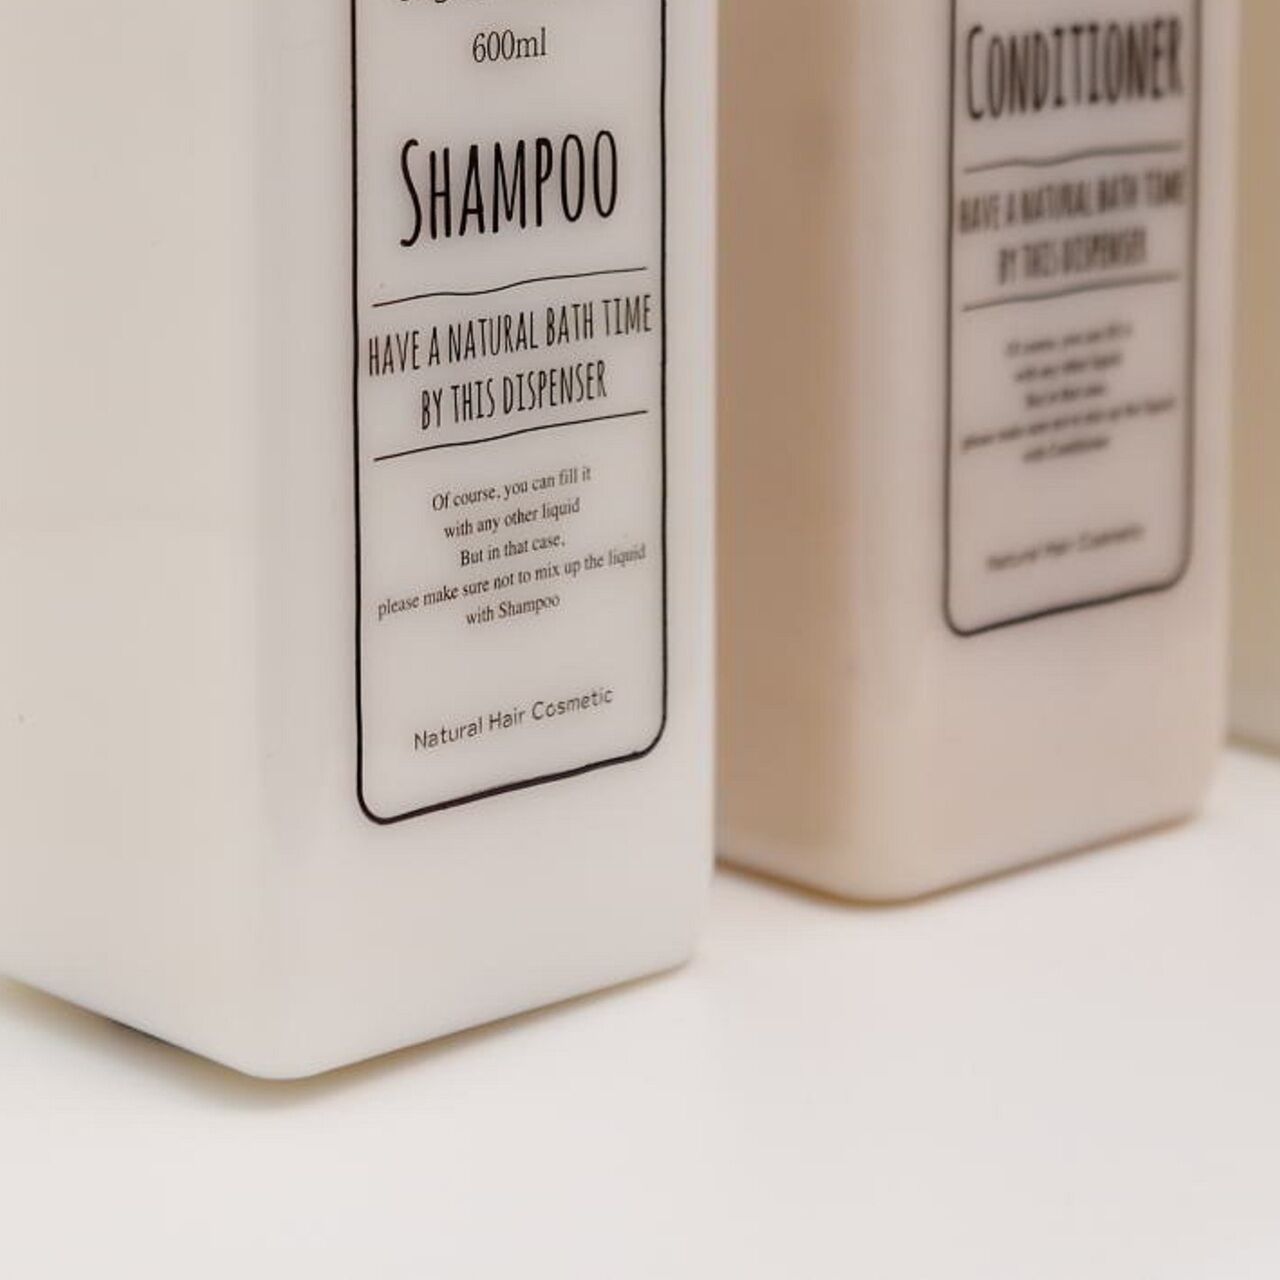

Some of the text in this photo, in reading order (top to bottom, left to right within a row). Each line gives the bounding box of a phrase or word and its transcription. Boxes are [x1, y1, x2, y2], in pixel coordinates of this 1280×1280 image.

[472, 27, 548, 63] 600ml
[966, 16, 1184, 122] CONDITIONER
[400, 130, 618, 247] SHAMPOO
[369, 294, 652, 376] HAVE A NATURAL BATH TIME
[421, 360, 607, 430] BY THIS DISPENSER
[432, 490, 450, 511] Of
[504, 481, 528, 500] you
[532, 477, 555, 492] can
[559, 468, 577, 486] fill
[582, 466, 591, 481] it
[444, 497, 580, 538] with any other liquid
[378, 542, 646, 621] please make sure not to mix up the liquid
[460, 548, 483, 567] But
[488, 544, 501, 560] in
[504, 539, 528, 557] that
[466, 595, 560, 624] with Shampoo
[414, 686, 614, 751] Natural Hair Cosmetic
